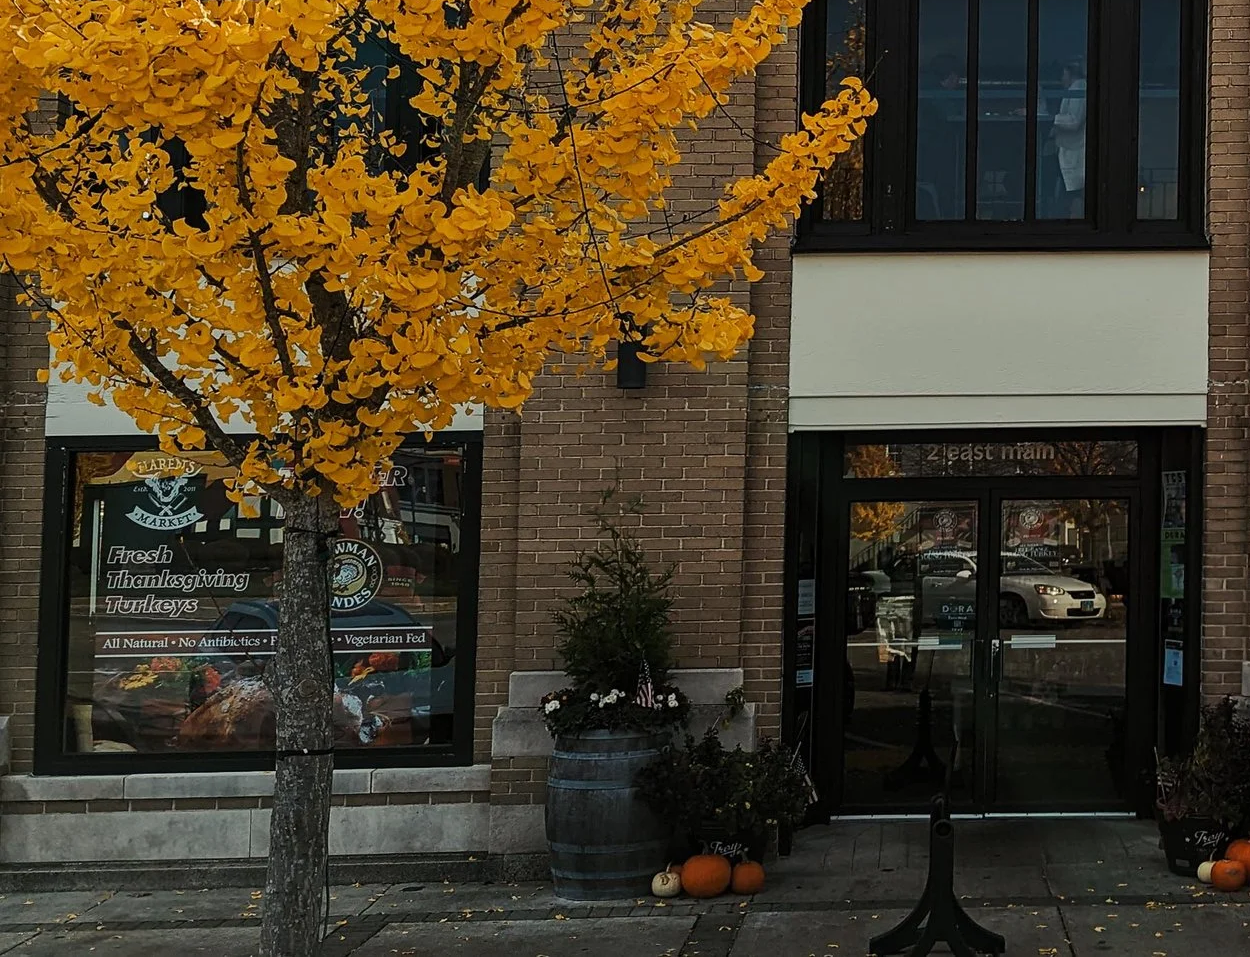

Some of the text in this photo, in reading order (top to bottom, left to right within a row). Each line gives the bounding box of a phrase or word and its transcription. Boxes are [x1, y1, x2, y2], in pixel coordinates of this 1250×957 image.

[926, 444, 1056, 461] 2 east main
[136, 513, 192, 528] MARKET
[107, 544, 173, 564] Fresh
[107, 568, 250, 593] Thanksgiving
[105, 595, 198, 618] Turkeys
[103, 637, 121, 649] All
[123, 637, 169, 649] Natural
[178, 638, 197, 648] No
[198, 635, 261, 648] Antibiotics
[344, 634, 405, 648] Vegetarian
[406, 632, 426, 645] Fed
